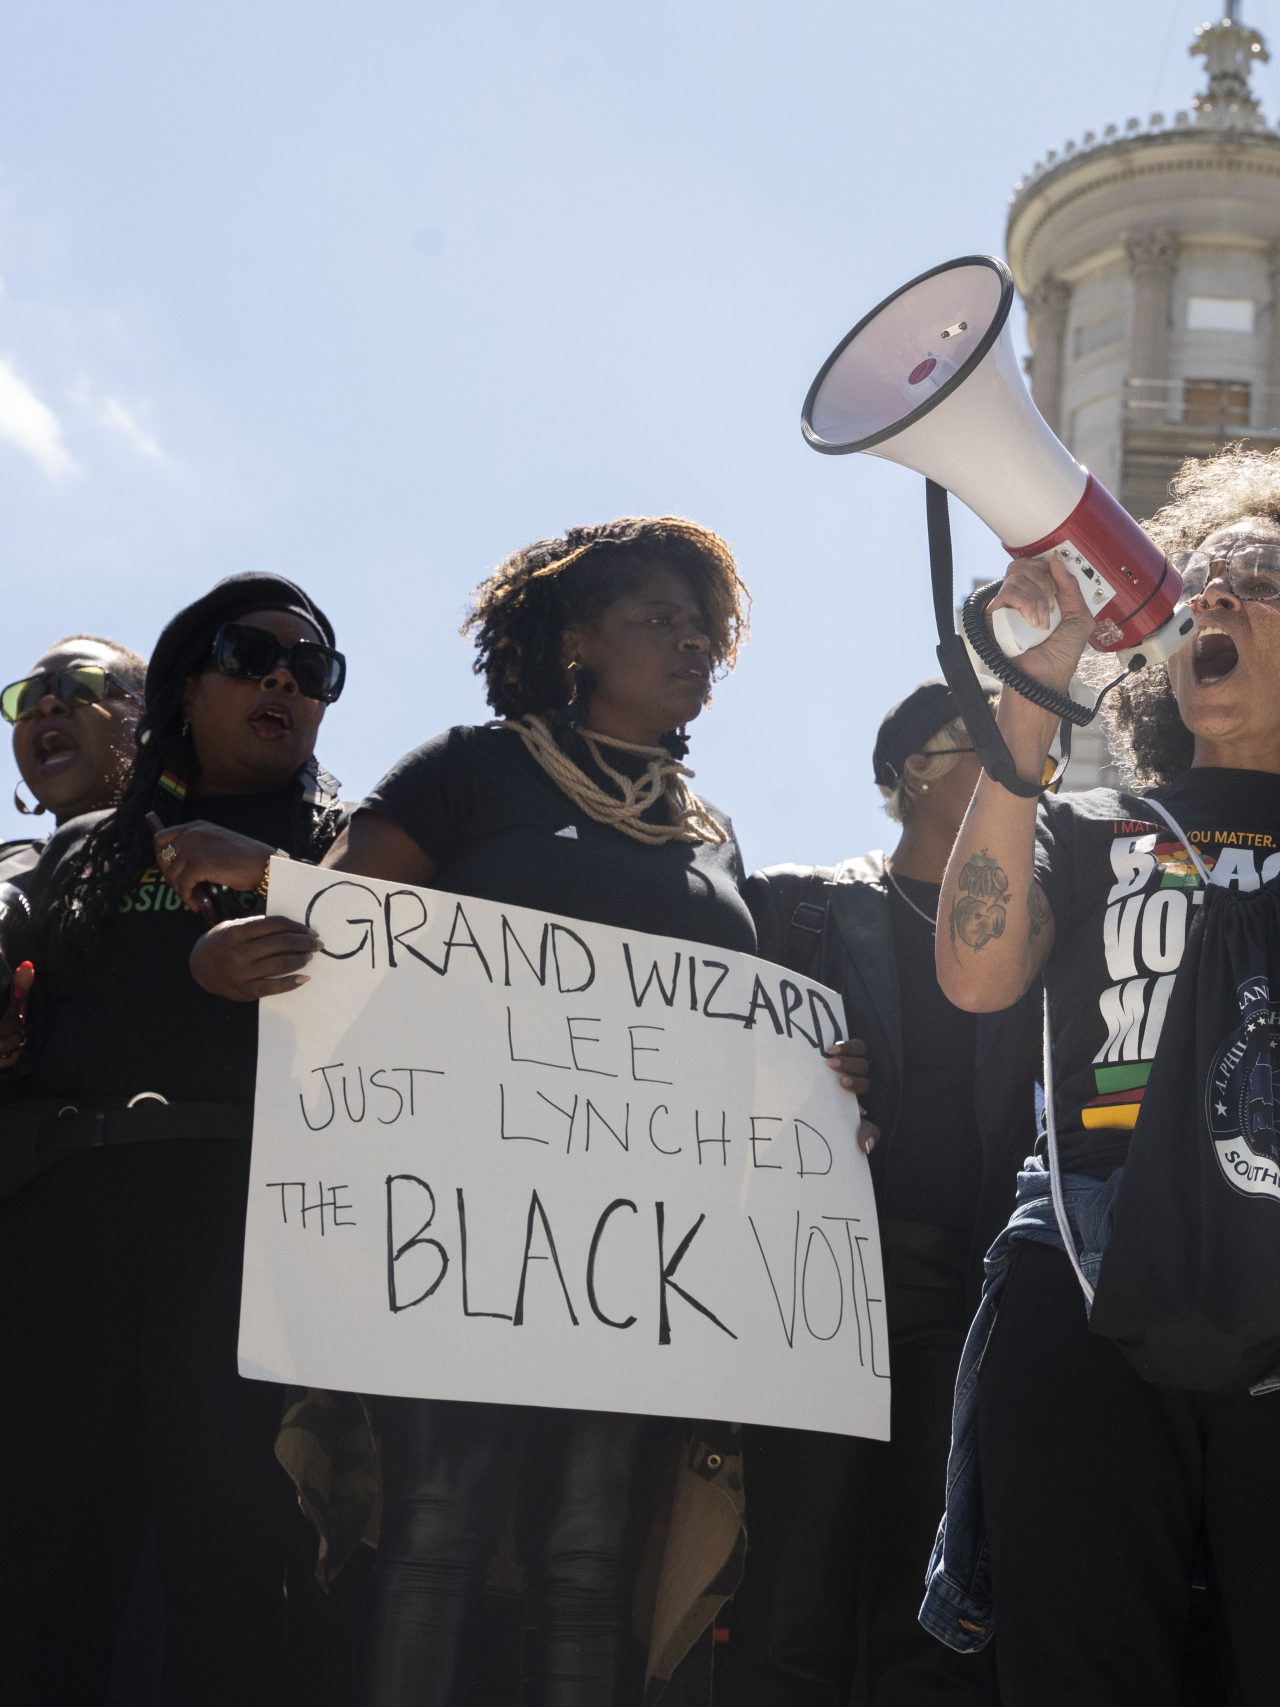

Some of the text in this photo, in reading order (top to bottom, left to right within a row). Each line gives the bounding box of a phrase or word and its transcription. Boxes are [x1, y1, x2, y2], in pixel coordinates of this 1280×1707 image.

[1215, 831, 1277, 848] MATTER.
[305, 880, 844, 1058] GRAND WIZARD
[507, 1005, 673, 1085] LEE
[299, 1062, 833, 1179] JUST LYNCHED
[266, 1173, 891, 1379] THE BLACK VOTE
